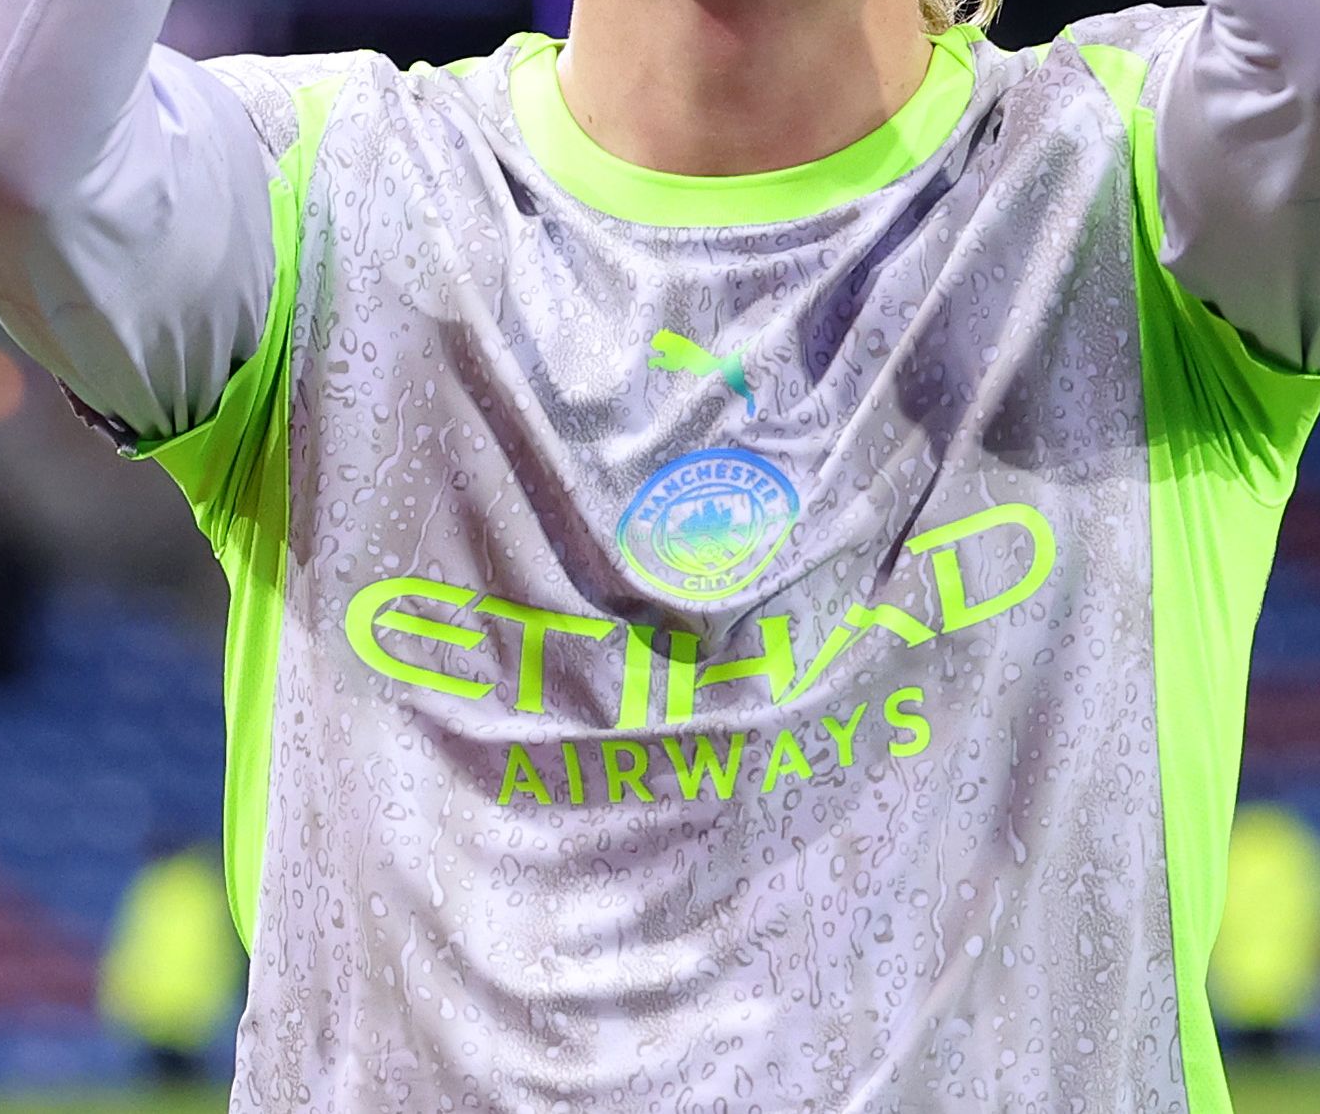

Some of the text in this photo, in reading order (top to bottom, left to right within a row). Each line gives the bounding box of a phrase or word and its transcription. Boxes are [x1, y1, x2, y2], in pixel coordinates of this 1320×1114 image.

[638, 463, 778, 522] MANCHESTER
[345, 502, 1056, 730] ETIHAD
[683, 572, 738, 591] CITY
[496, 686, 931, 806] AIRWAYS
